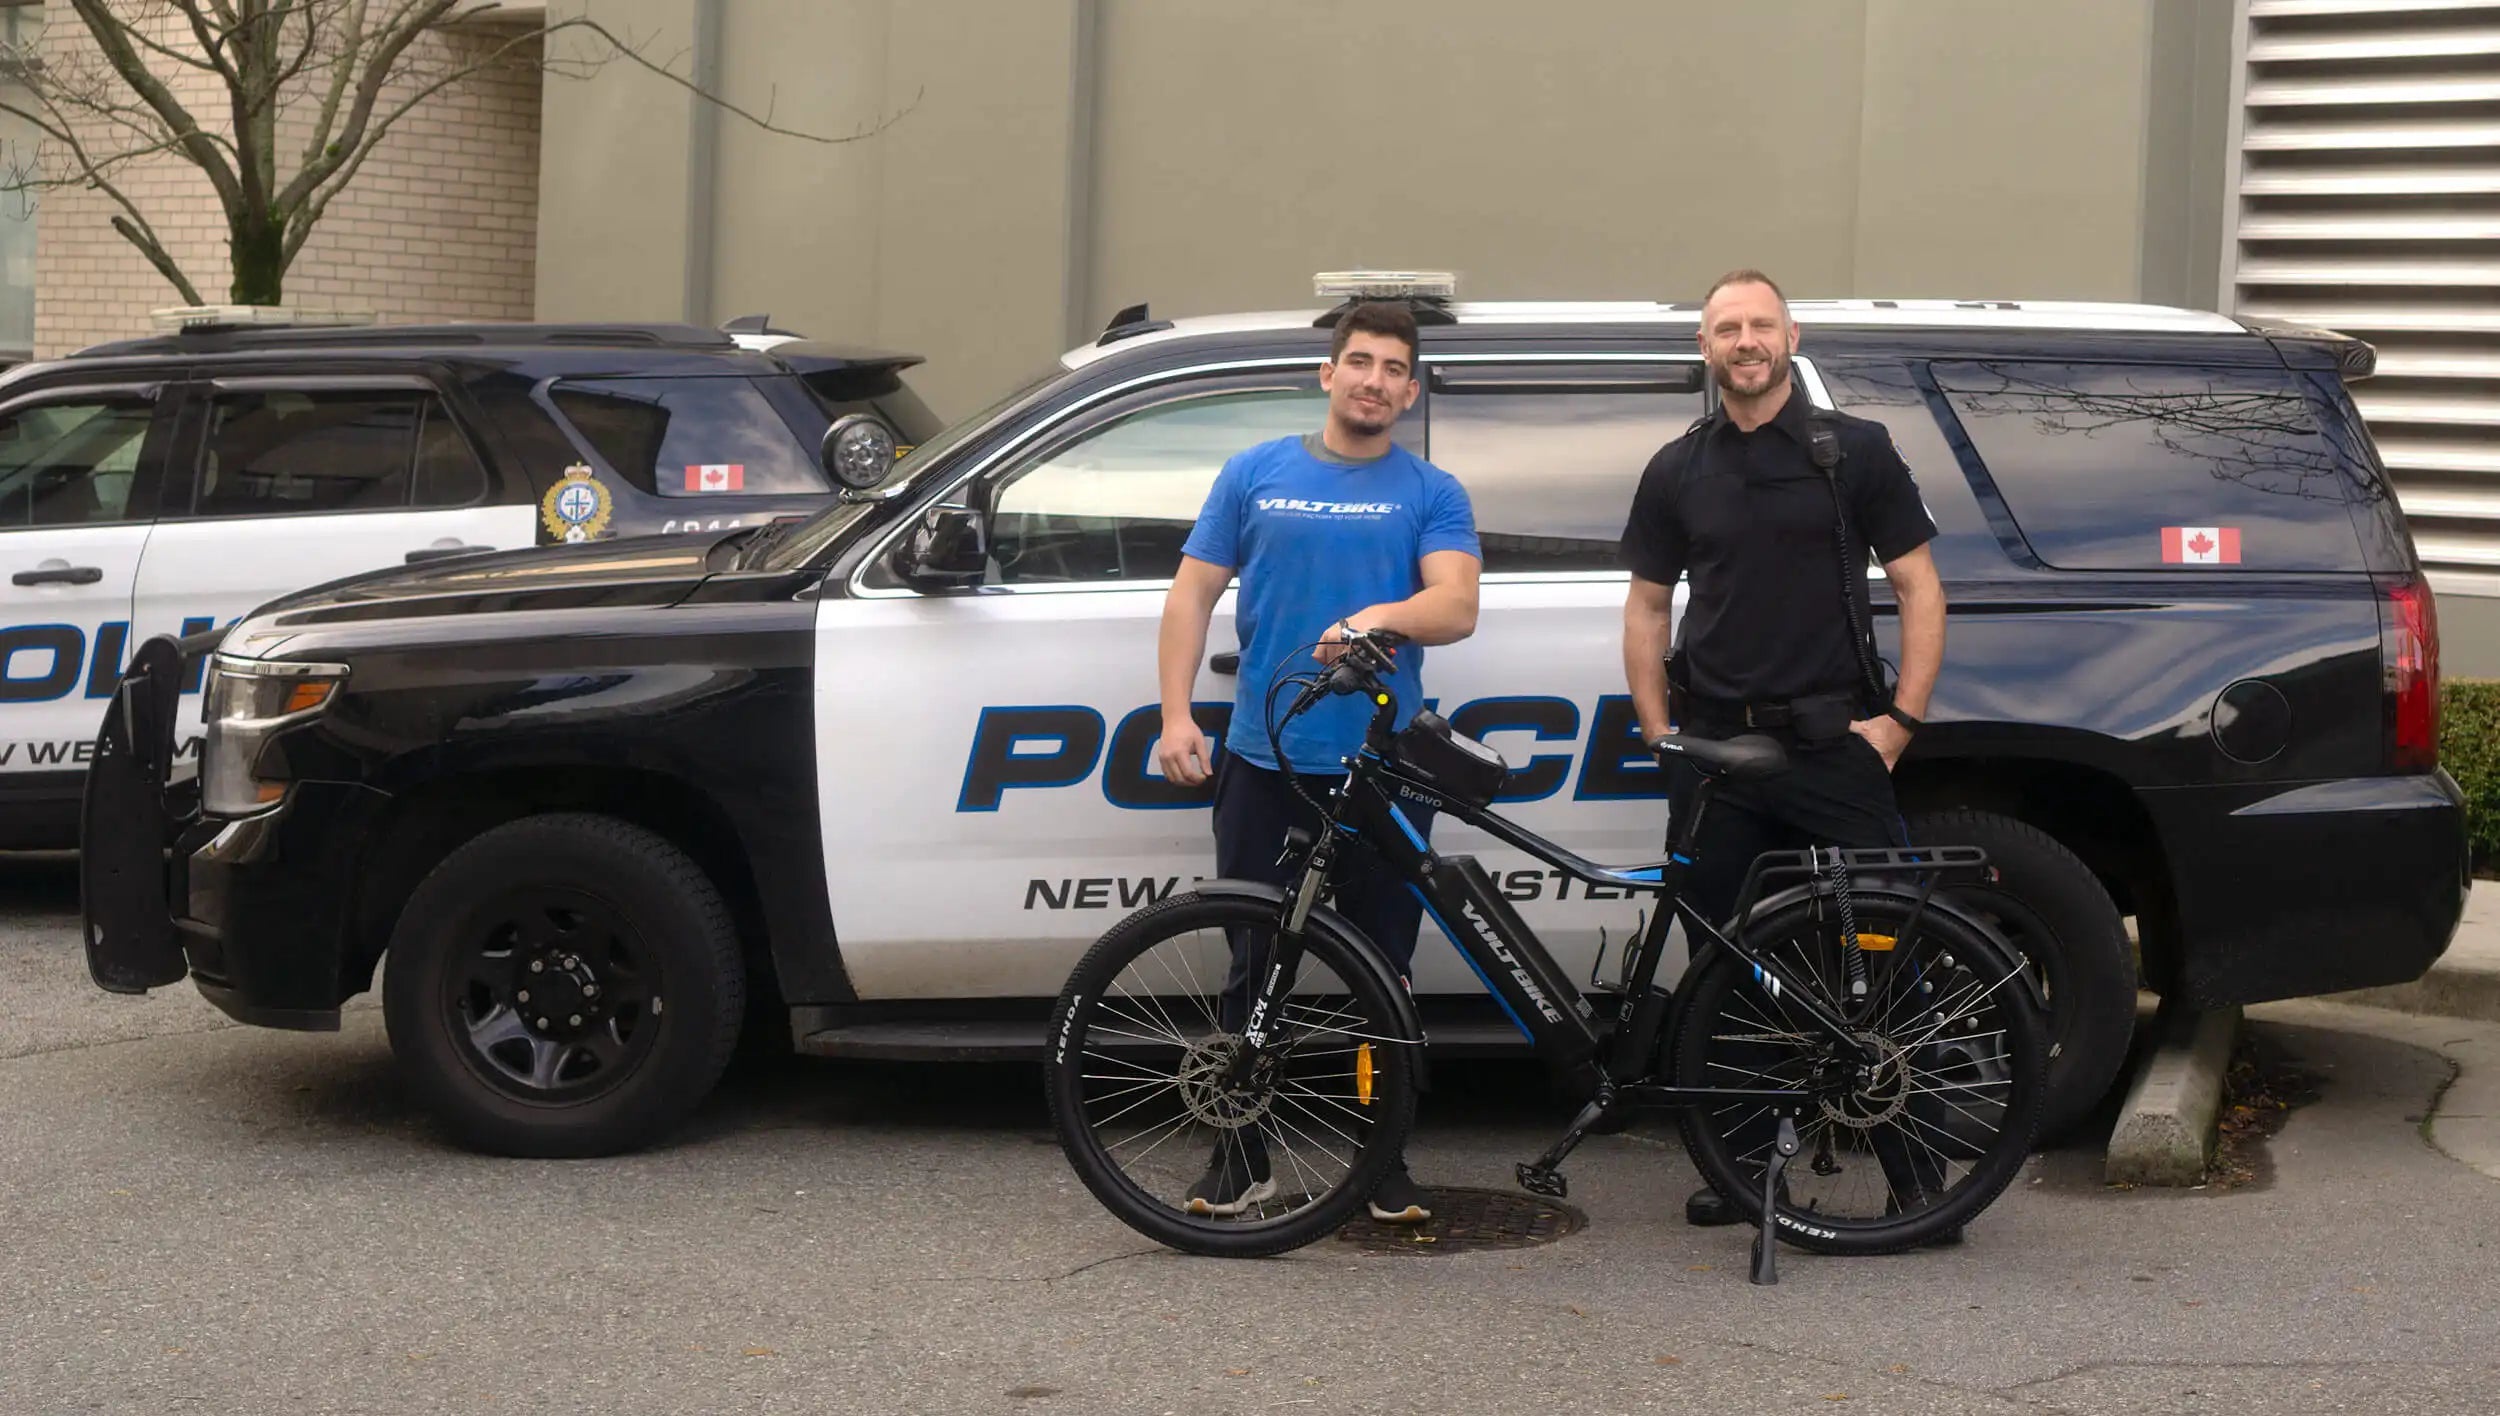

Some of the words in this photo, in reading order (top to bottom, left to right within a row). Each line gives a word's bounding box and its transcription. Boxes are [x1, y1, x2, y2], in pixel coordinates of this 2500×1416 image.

[1257, 499, 1393, 513] VULTBIKE
[956, 696, 1676, 812] POCE
[1400, 785, 1442, 807] Bravo
[1024, 877, 1179, 909] NEW
[1462, 900, 1563, 1024] VULTBIKE
[1056, 994, 1083, 1065] KENDA
[1245, 998, 1268, 1045] XCM
[1775, 1213, 1837, 1239] KEND
